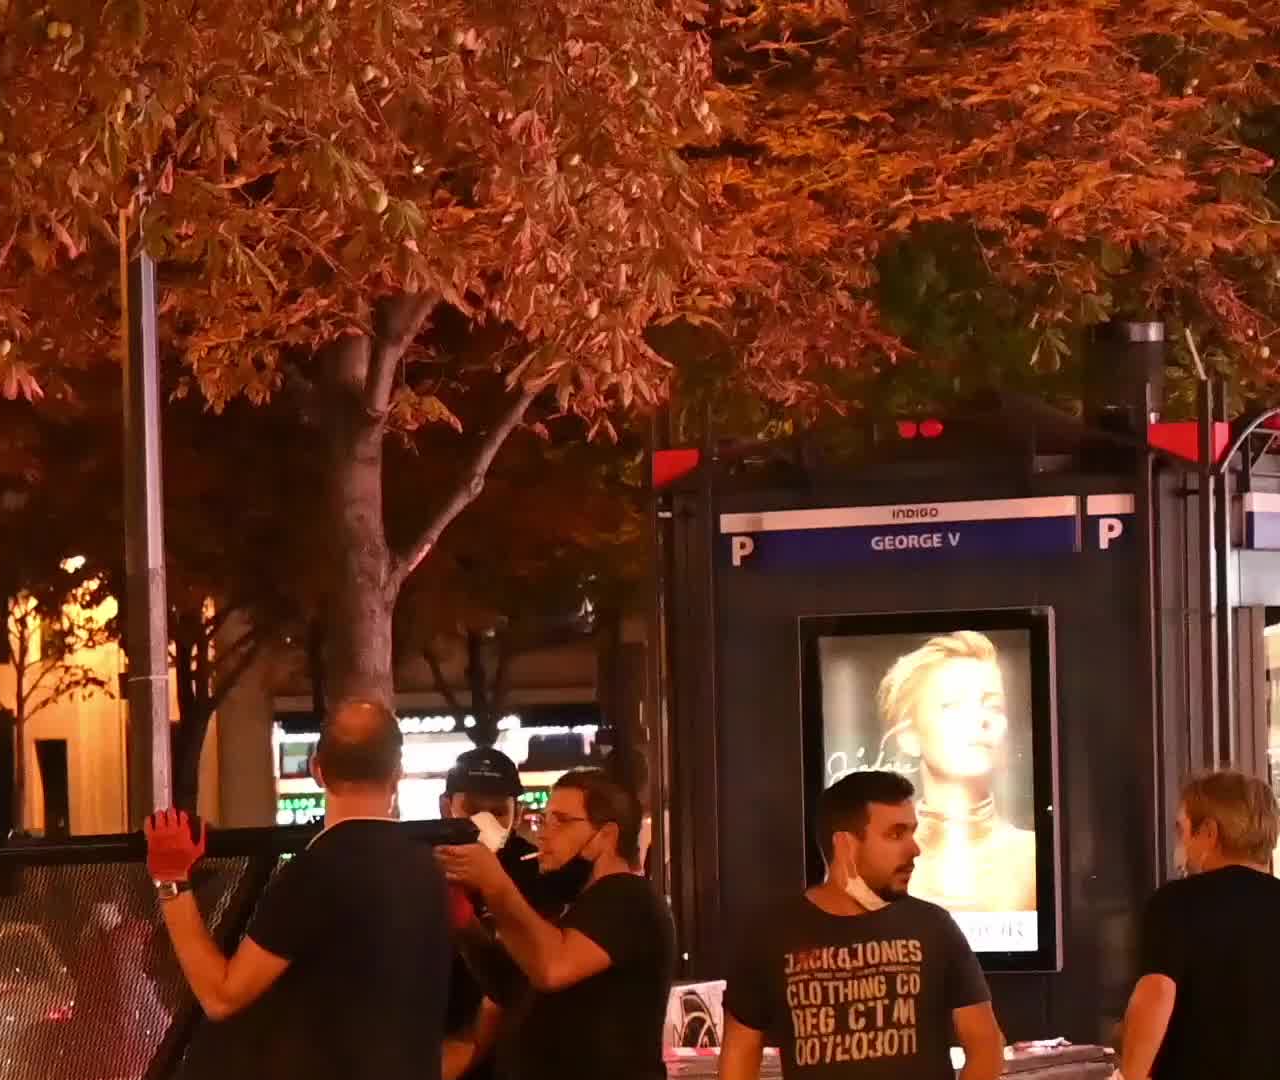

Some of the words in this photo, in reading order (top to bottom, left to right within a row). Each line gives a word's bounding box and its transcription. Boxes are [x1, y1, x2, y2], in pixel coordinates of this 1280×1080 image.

[892, 507, 939, 519] INDIGO
[871, 533, 943, 551] GEORGE
[947, 532, 961, 547] V
[1098, 517, 1123, 550] P
[731, 535, 755, 567] P
[786, 975, 887, 1007] CLOTHING
[896, 973, 920, 995] CO
